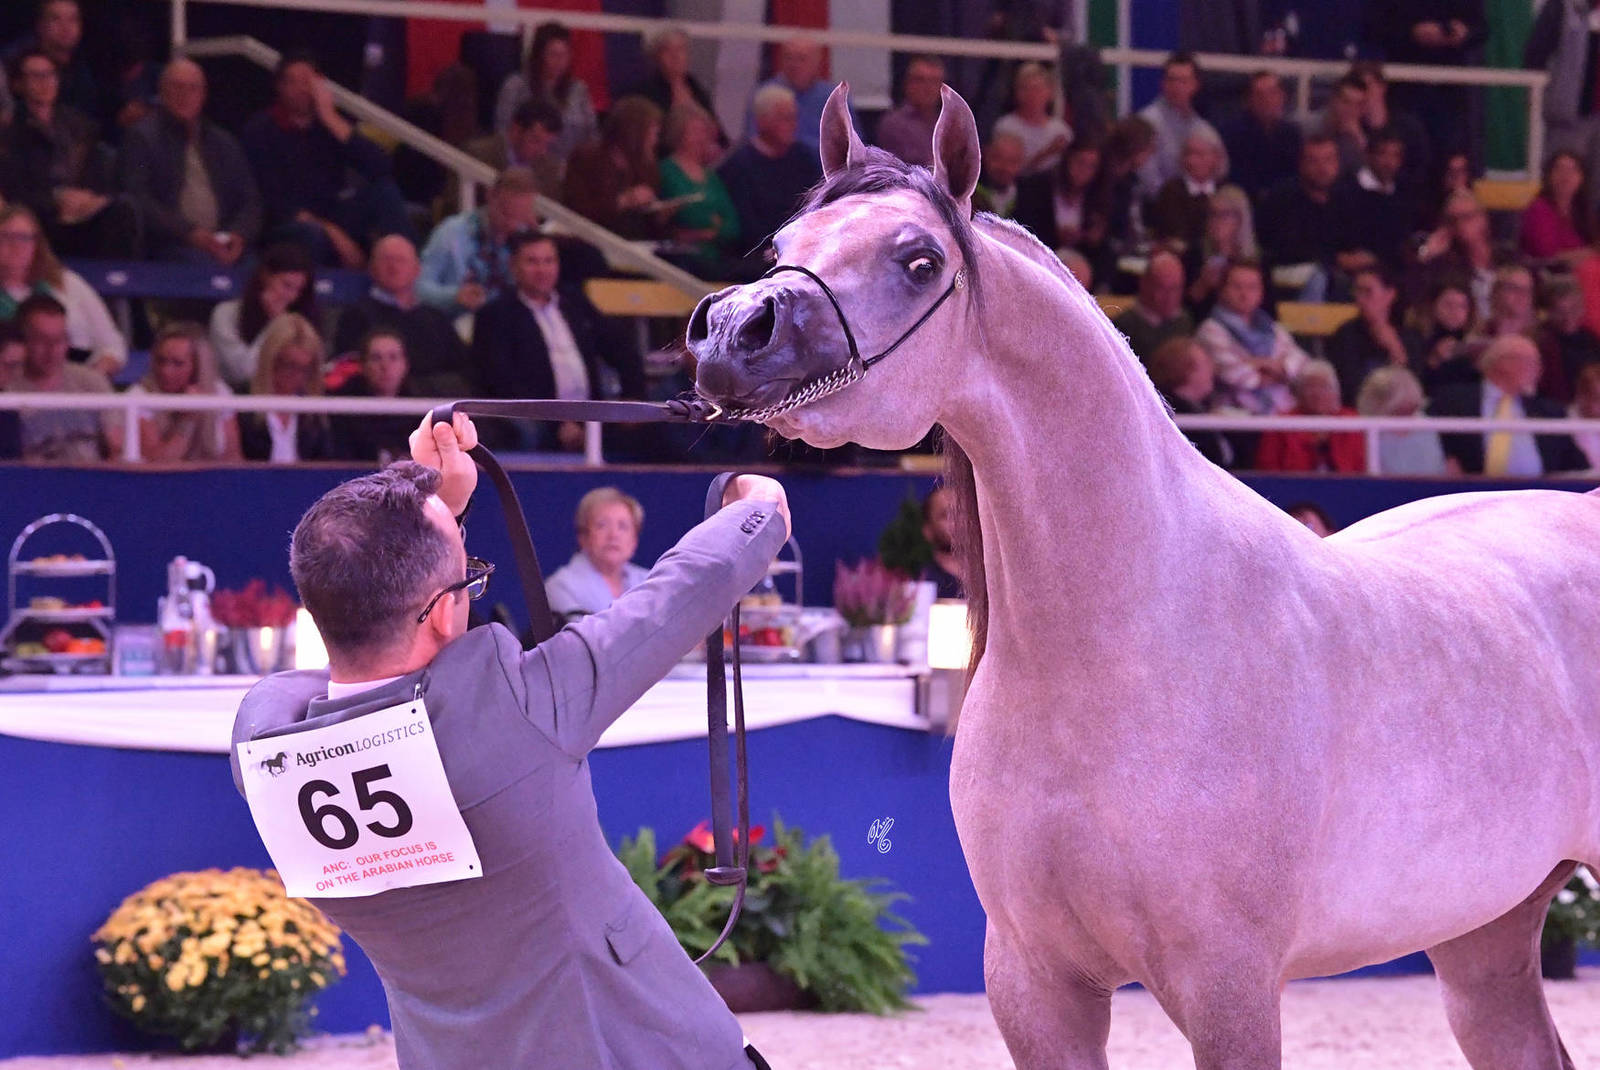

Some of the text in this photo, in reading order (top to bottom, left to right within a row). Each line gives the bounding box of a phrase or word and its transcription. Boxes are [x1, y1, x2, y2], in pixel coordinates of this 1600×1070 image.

[297, 763, 413, 850] 65
[316, 851, 455, 892] ON THE ARABIAN HORSE
[322, 841, 438, 875] ANC: OUR FOCUS IS
